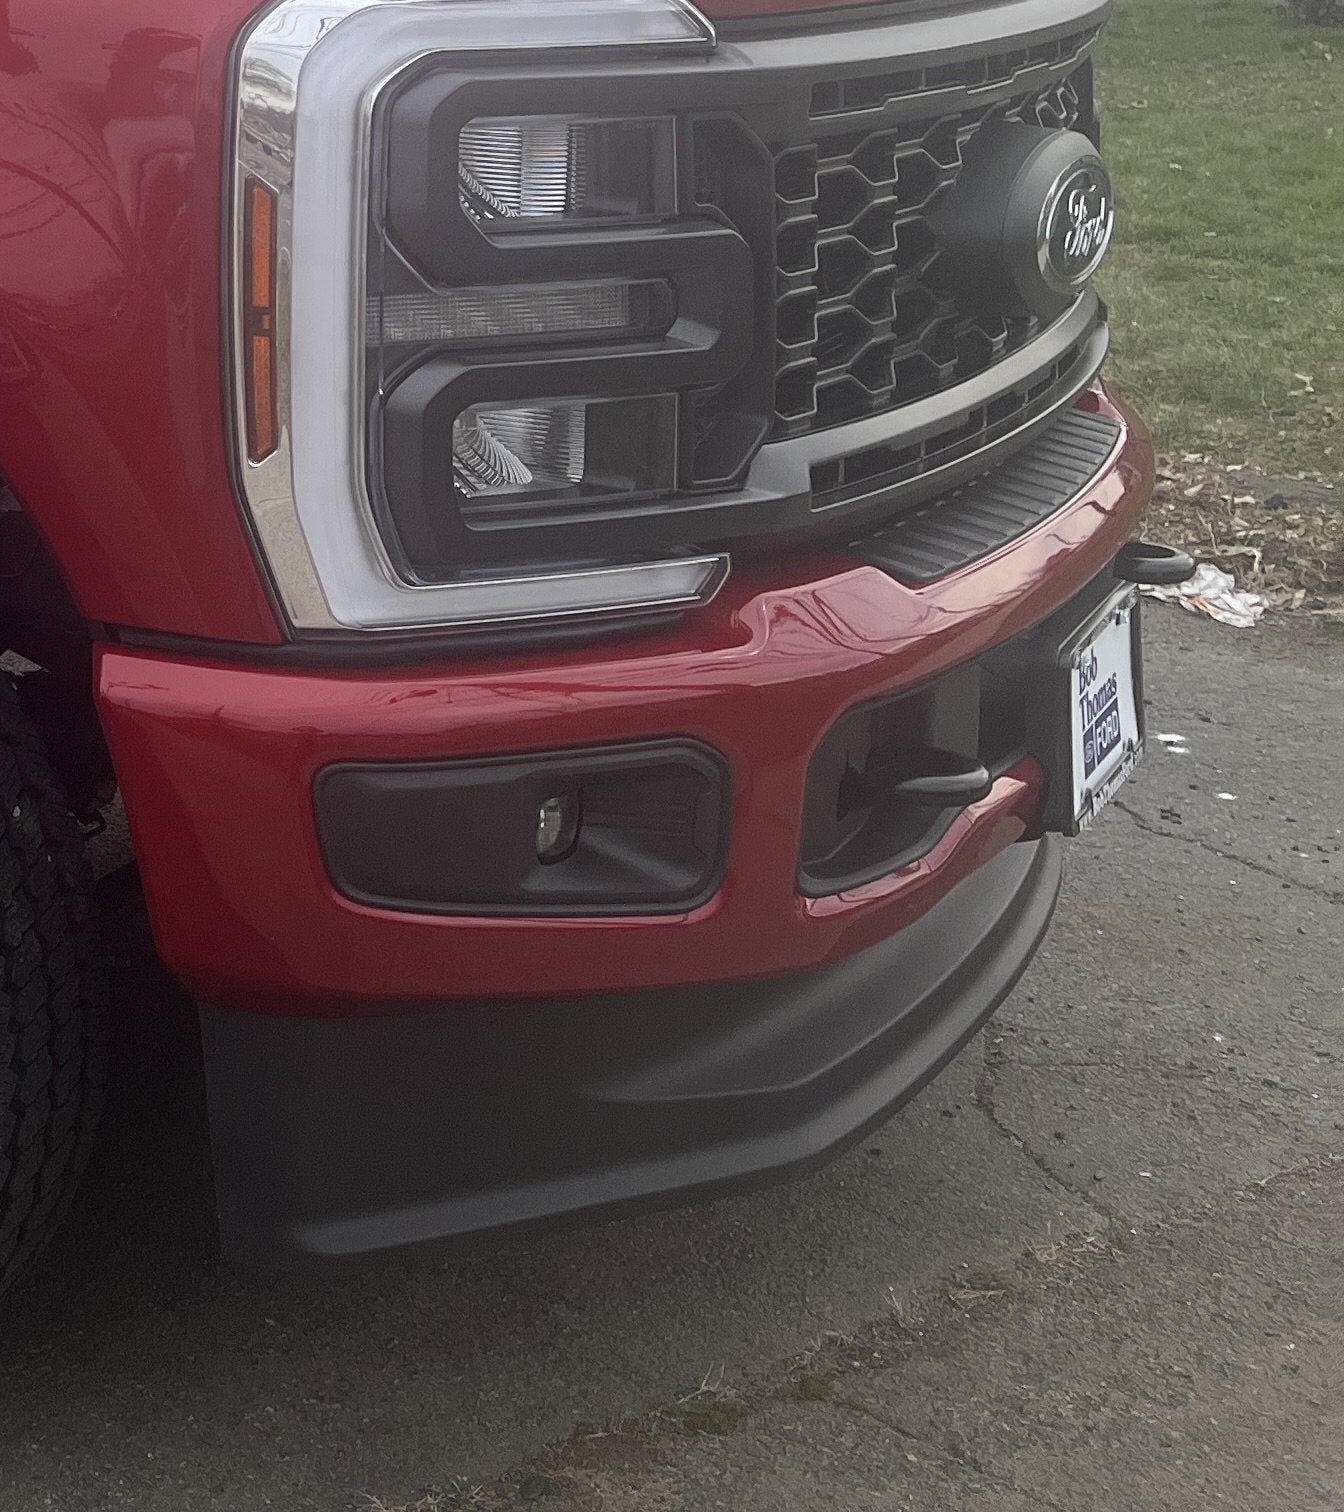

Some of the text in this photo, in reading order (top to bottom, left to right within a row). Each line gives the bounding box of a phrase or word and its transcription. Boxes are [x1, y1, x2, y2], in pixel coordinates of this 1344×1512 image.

[1079, 646, 1098, 697] Bob
[1079, 672, 1117, 732] Thomas
[1097, 710, 1119, 756] FORD
